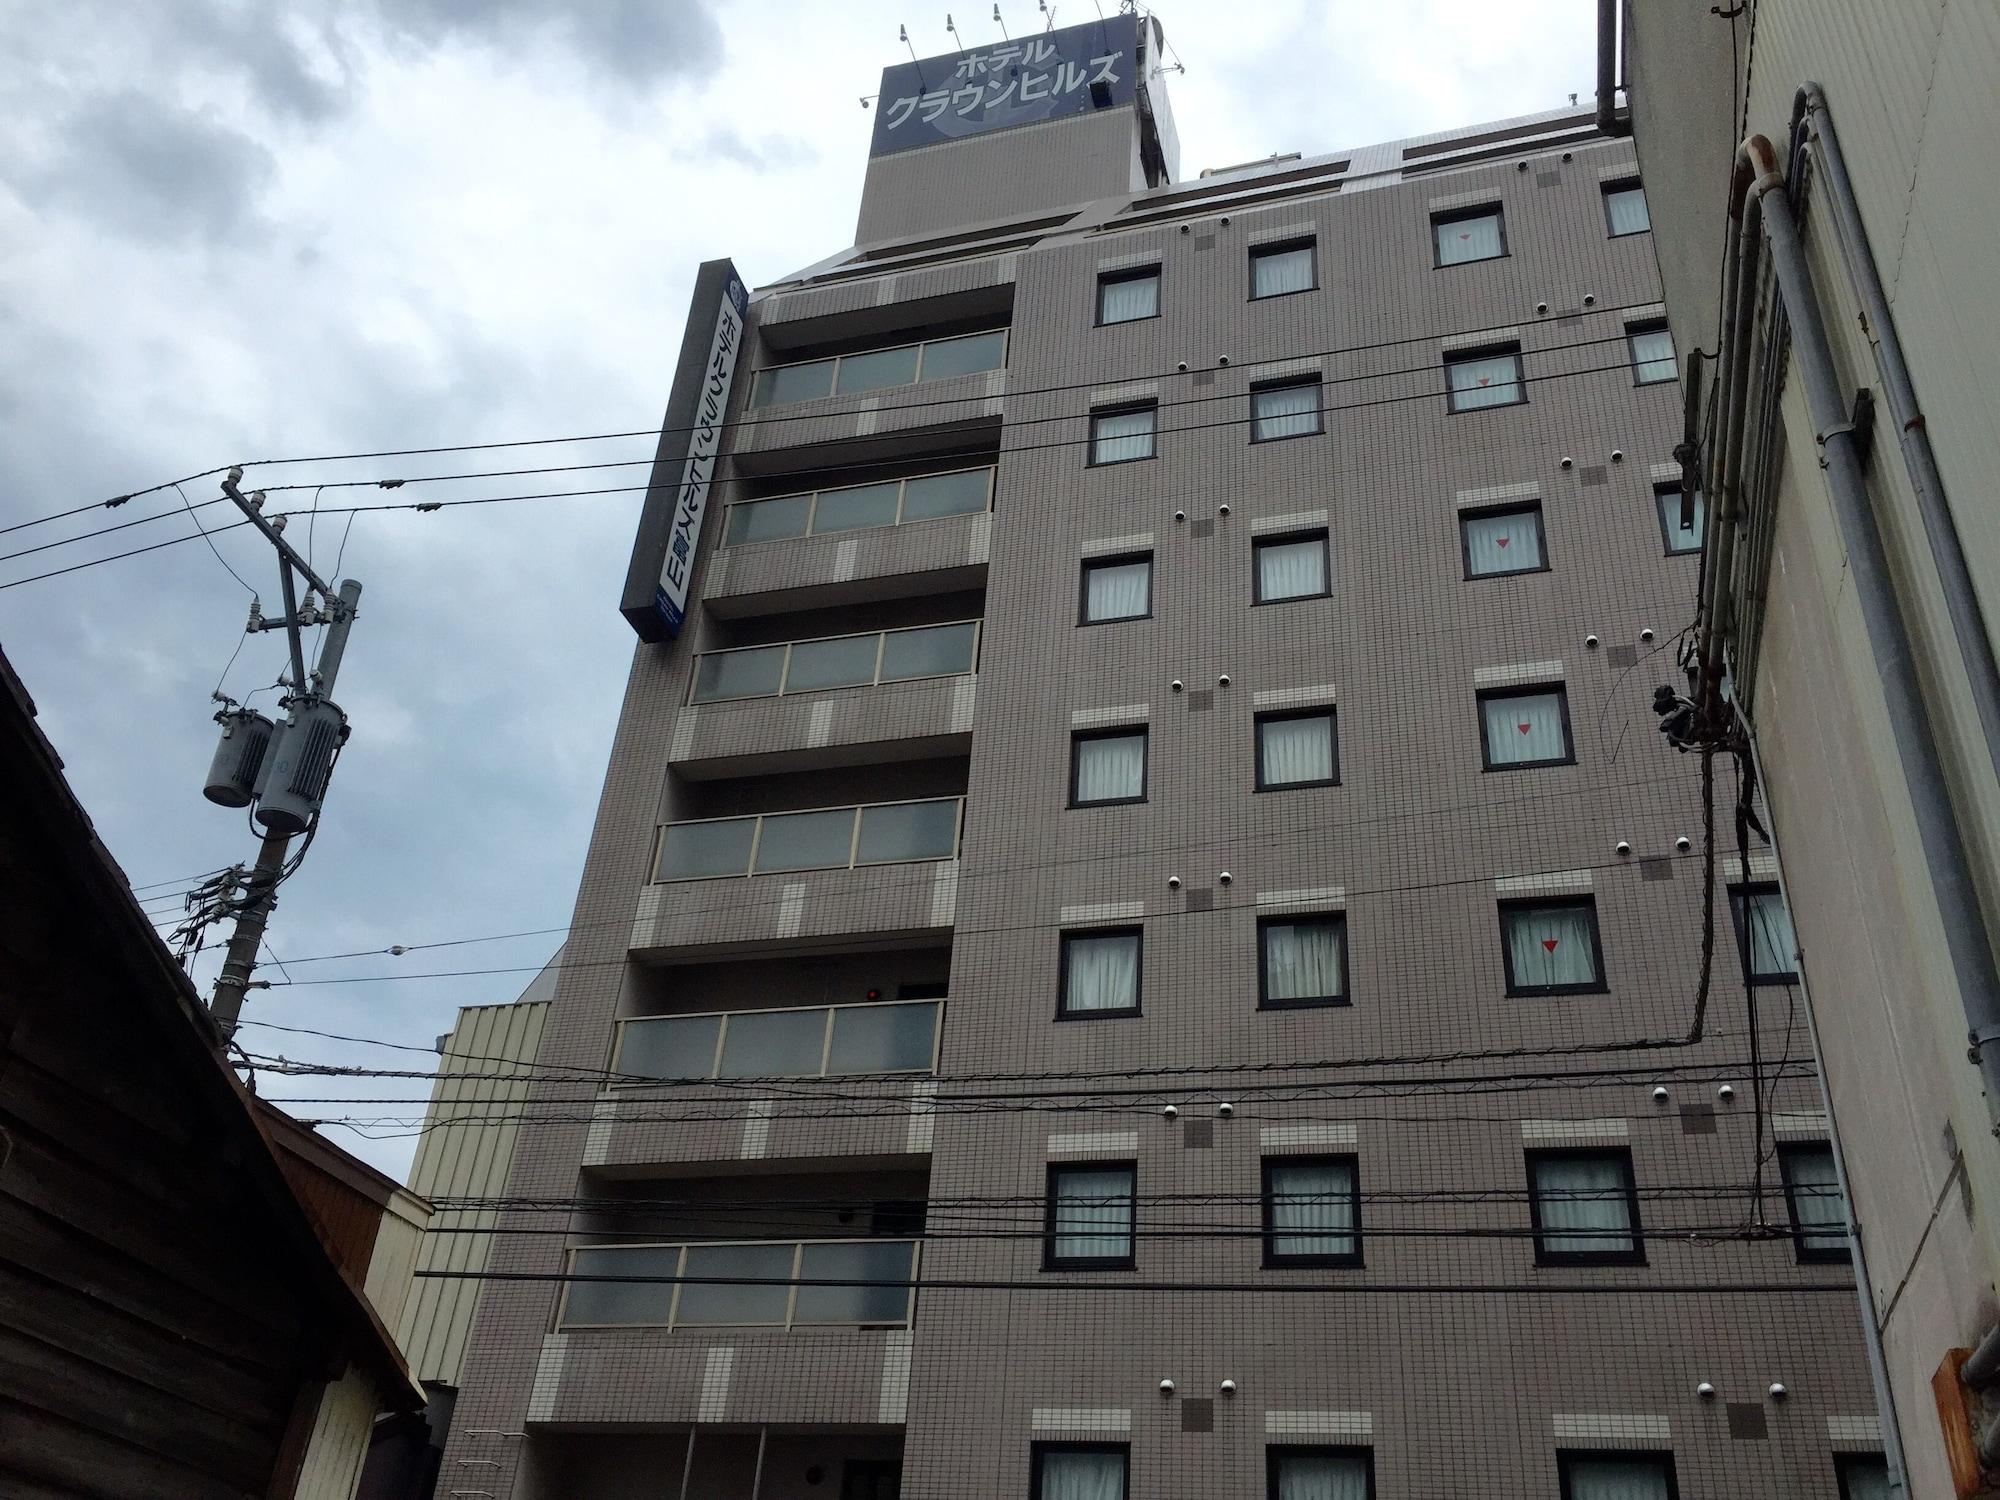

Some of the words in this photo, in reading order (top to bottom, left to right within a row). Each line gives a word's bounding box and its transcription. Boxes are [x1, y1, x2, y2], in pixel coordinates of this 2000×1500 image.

[886, 50, 1123, 130] クラウンヒルズ
[955, 39, 1056, 79] ホテル
[666, 310, 737, 592] ホテルクラウンヒルズ富山
